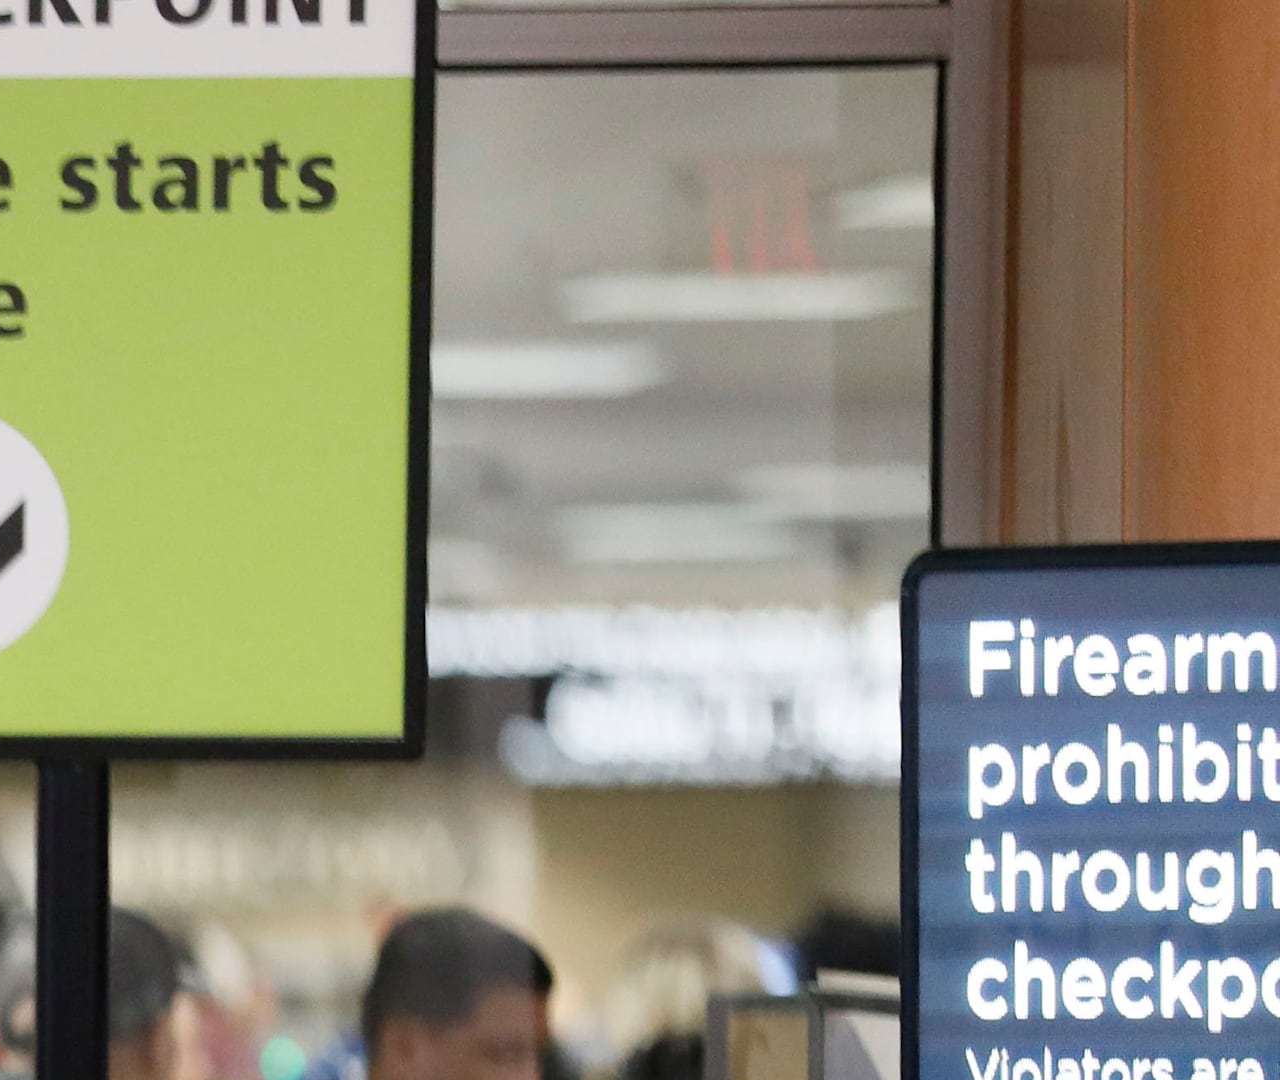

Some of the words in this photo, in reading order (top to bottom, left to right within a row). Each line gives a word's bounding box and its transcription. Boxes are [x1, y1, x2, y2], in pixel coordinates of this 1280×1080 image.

[59, 139, 338, 213] starts
[968, 617, 1277, 698] Firearm
[967, 721, 1280, 819] prohibit
[964, 830, 1280, 925] through
